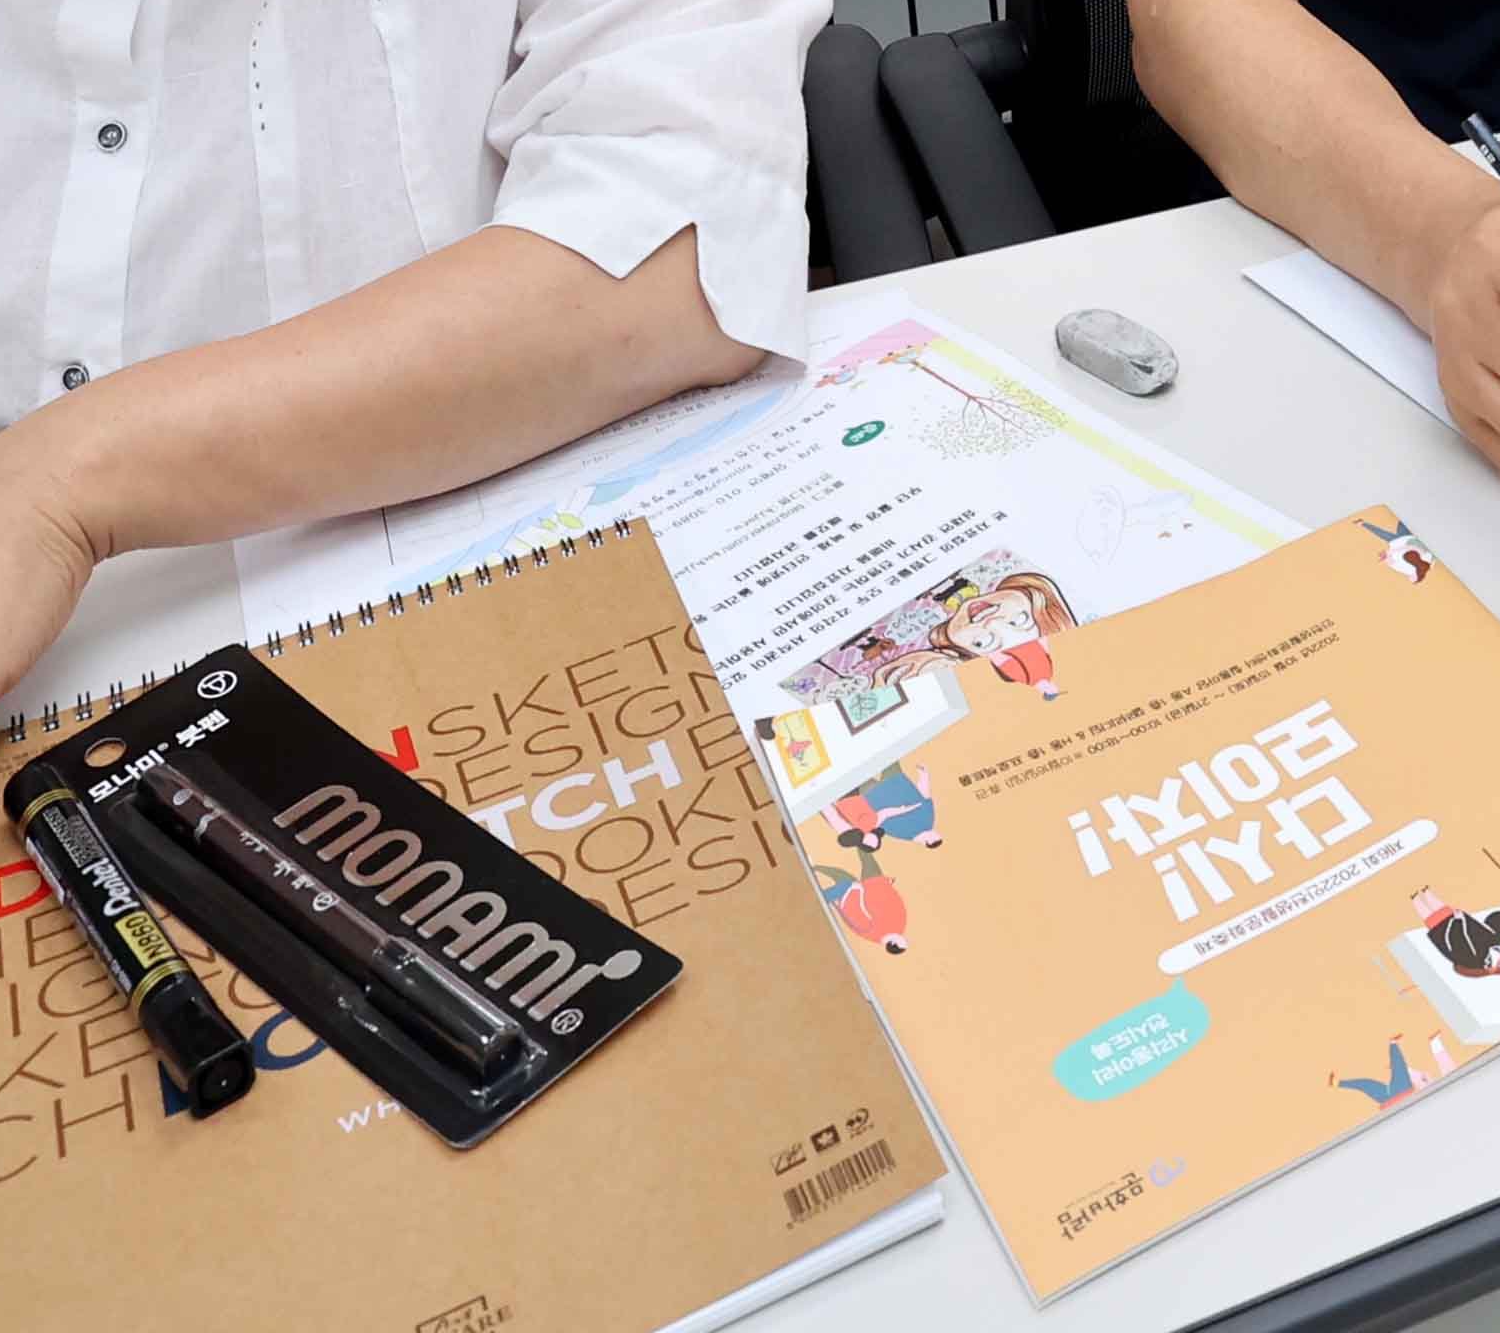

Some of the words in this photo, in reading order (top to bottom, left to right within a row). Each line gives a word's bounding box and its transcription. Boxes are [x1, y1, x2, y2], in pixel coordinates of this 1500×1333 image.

[1272, 655, 1299, 673] 10월
[1299, 632, 1340, 659] 2022년
[87, 748, 166, 804] 모나미
[175, 708, 231, 748] 붓펜
[1067, 700, 1358, 877] 모이자!
[1152, 776, 1373, 922] 다시!
[1361, 839, 1405, 870] 제6회
[81, 856, 141, 918] Pentel
[1193, 863, 1361, 956] 2022인천생활문화축제
[124, 915, 168, 961] N860
[1056, 1172, 1145, 1241] 문화바람
